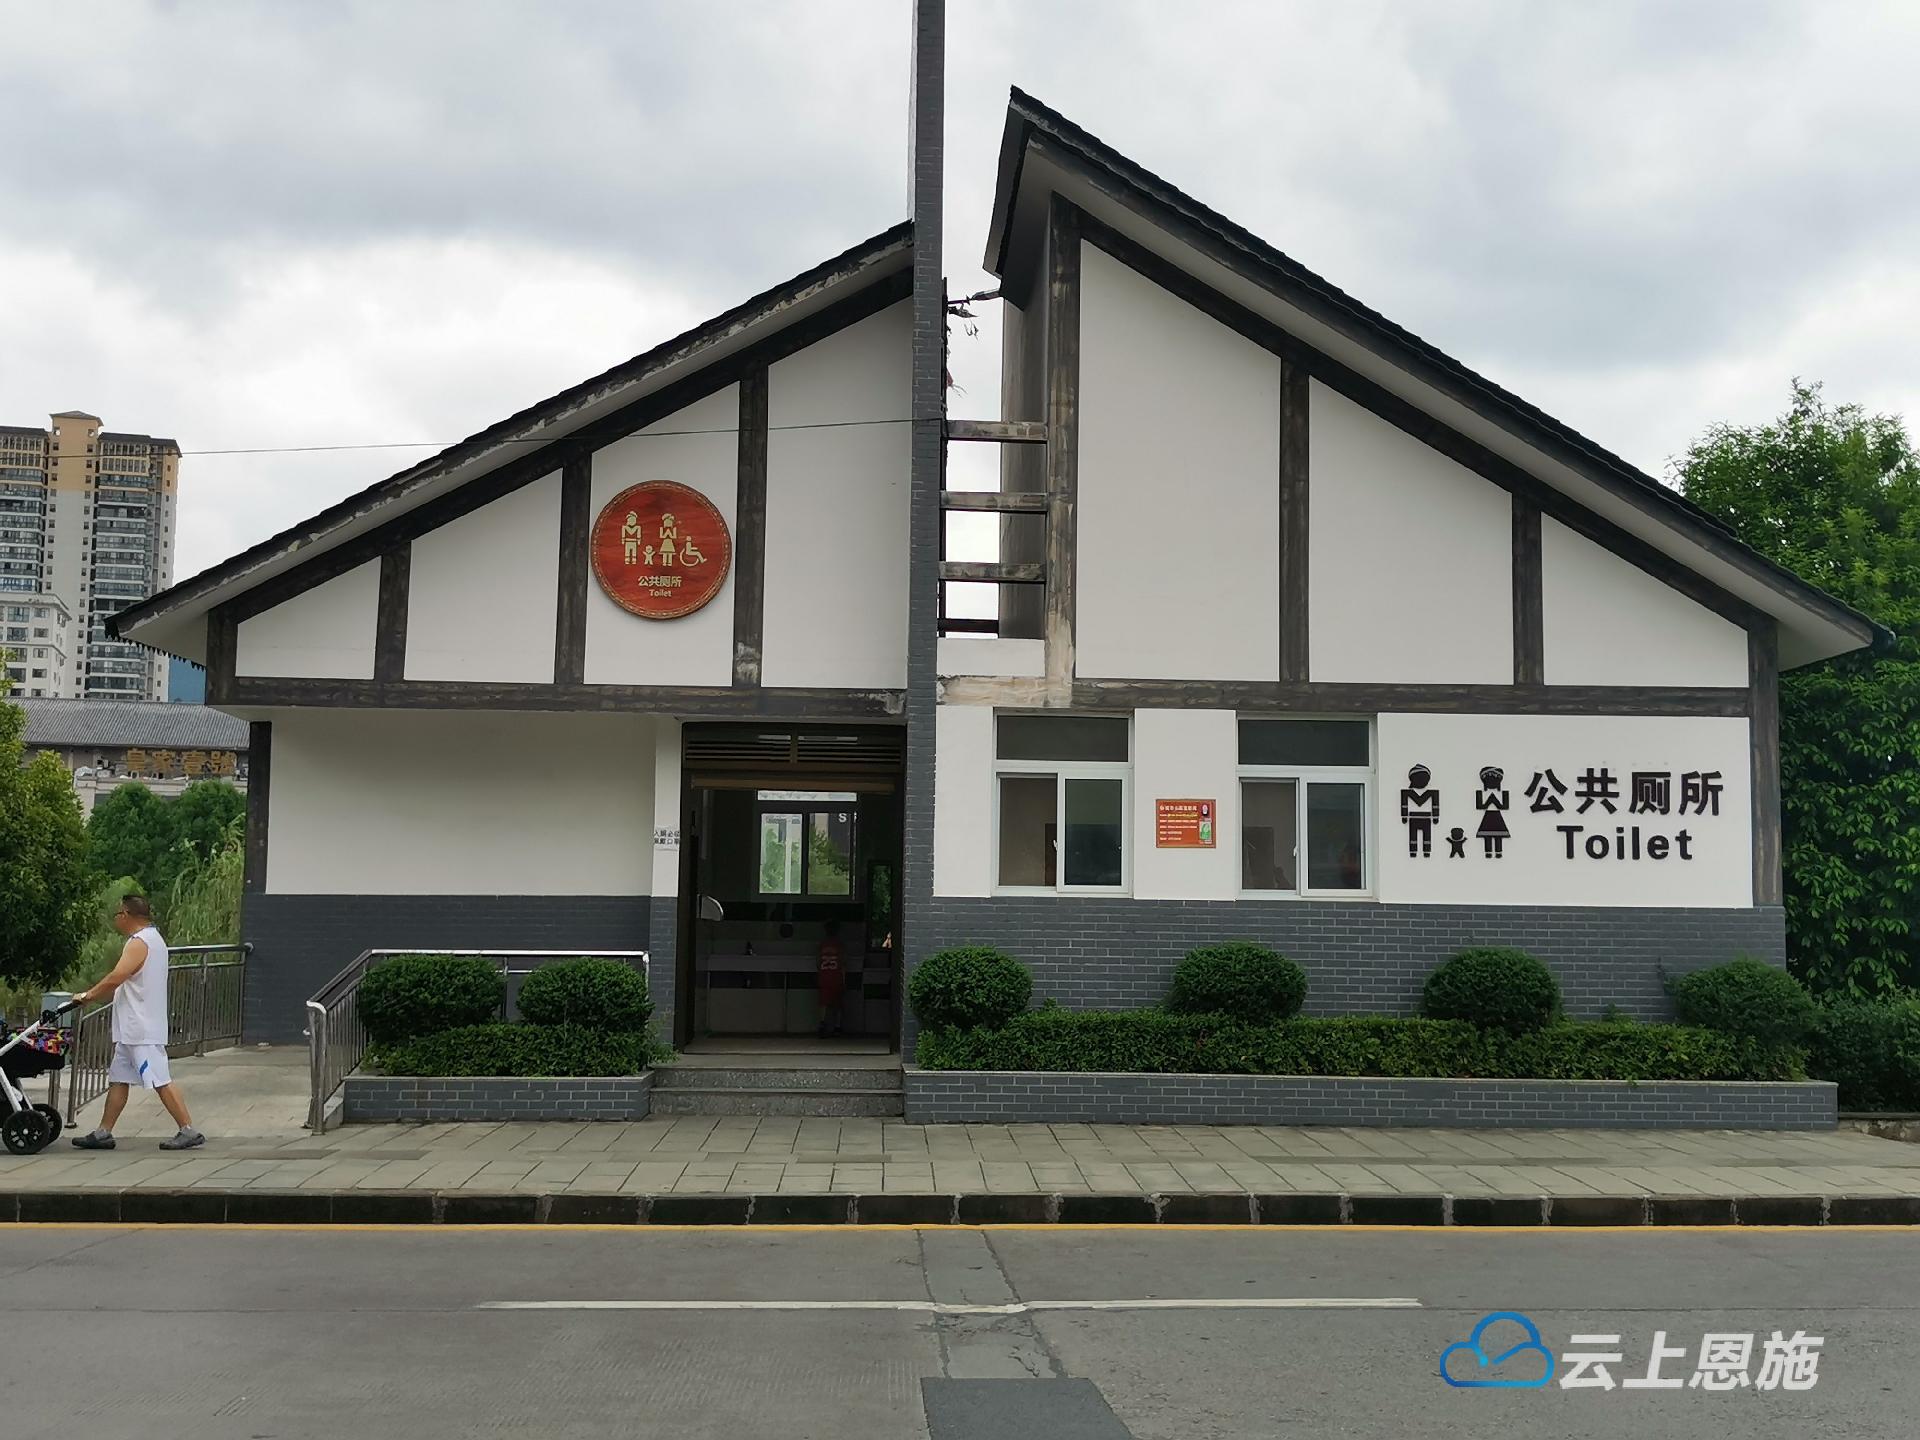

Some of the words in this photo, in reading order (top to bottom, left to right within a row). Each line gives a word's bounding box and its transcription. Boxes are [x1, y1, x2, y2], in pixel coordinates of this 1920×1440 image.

[637, 575, 683, 588] 公共厕所
[648, 589, 672, 597] Toilet
[1524, 768, 1724, 817] 公共厕所
[1556, 825, 1693, 861] Toilet
